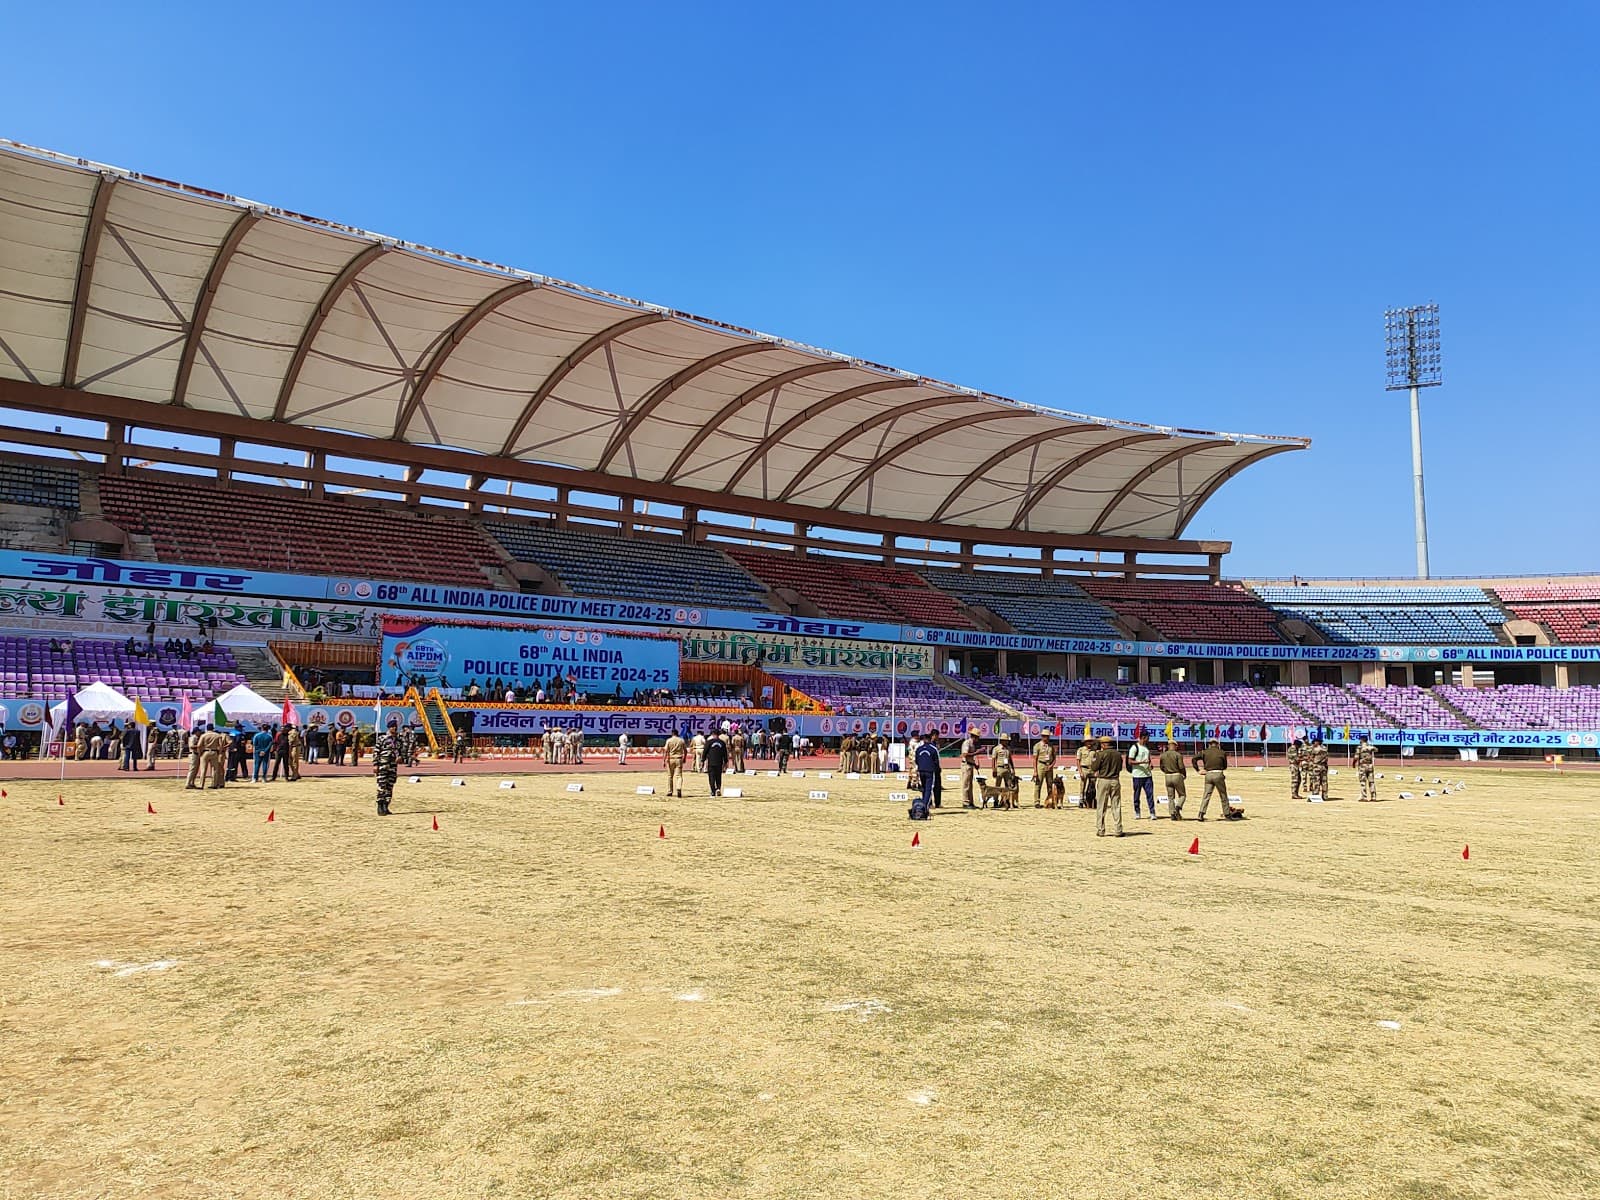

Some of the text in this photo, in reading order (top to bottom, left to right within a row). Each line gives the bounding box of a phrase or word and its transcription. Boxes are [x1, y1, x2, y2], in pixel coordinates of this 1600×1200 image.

[21, 558, 252, 591] जोहार
[377, 585, 672, 621] 68th ALL INDIA POLICE DUTY MEET 2024-25
[752, 617, 864, 637] जोहार
[926, 630, 1111, 652] 68th ALL INDIA POLICE DUTY MEET 2024-25
[407, 651, 443, 661] AIPDM
[519, 645, 624, 664] 68th ALL INDIA
[1167, 644, 1376, 659] 68th ALL INDIA POLICE DUTY MEET 2024-25
[1442, 649, 1464, 659] 68th
[1466, 649, 1488, 659] ALL
[1490, 649, 1524, 659] INDIA
[1526, 649, 1568, 659] POLICE
[464, 660, 670, 683] POLICE DUTY MEET 2024-25
[481, 712, 536, 729] अखिल
[599, 714, 641, 732] पुलिस
[644, 714, 677, 733] ड्यूटी
[1418, 732, 1450, 744] पुलिस
[1452, 732, 1480, 746] ड्यूटी
[1484, 732, 1505, 744] मीट
[1508, 735, 1562, 744] 2024-25
